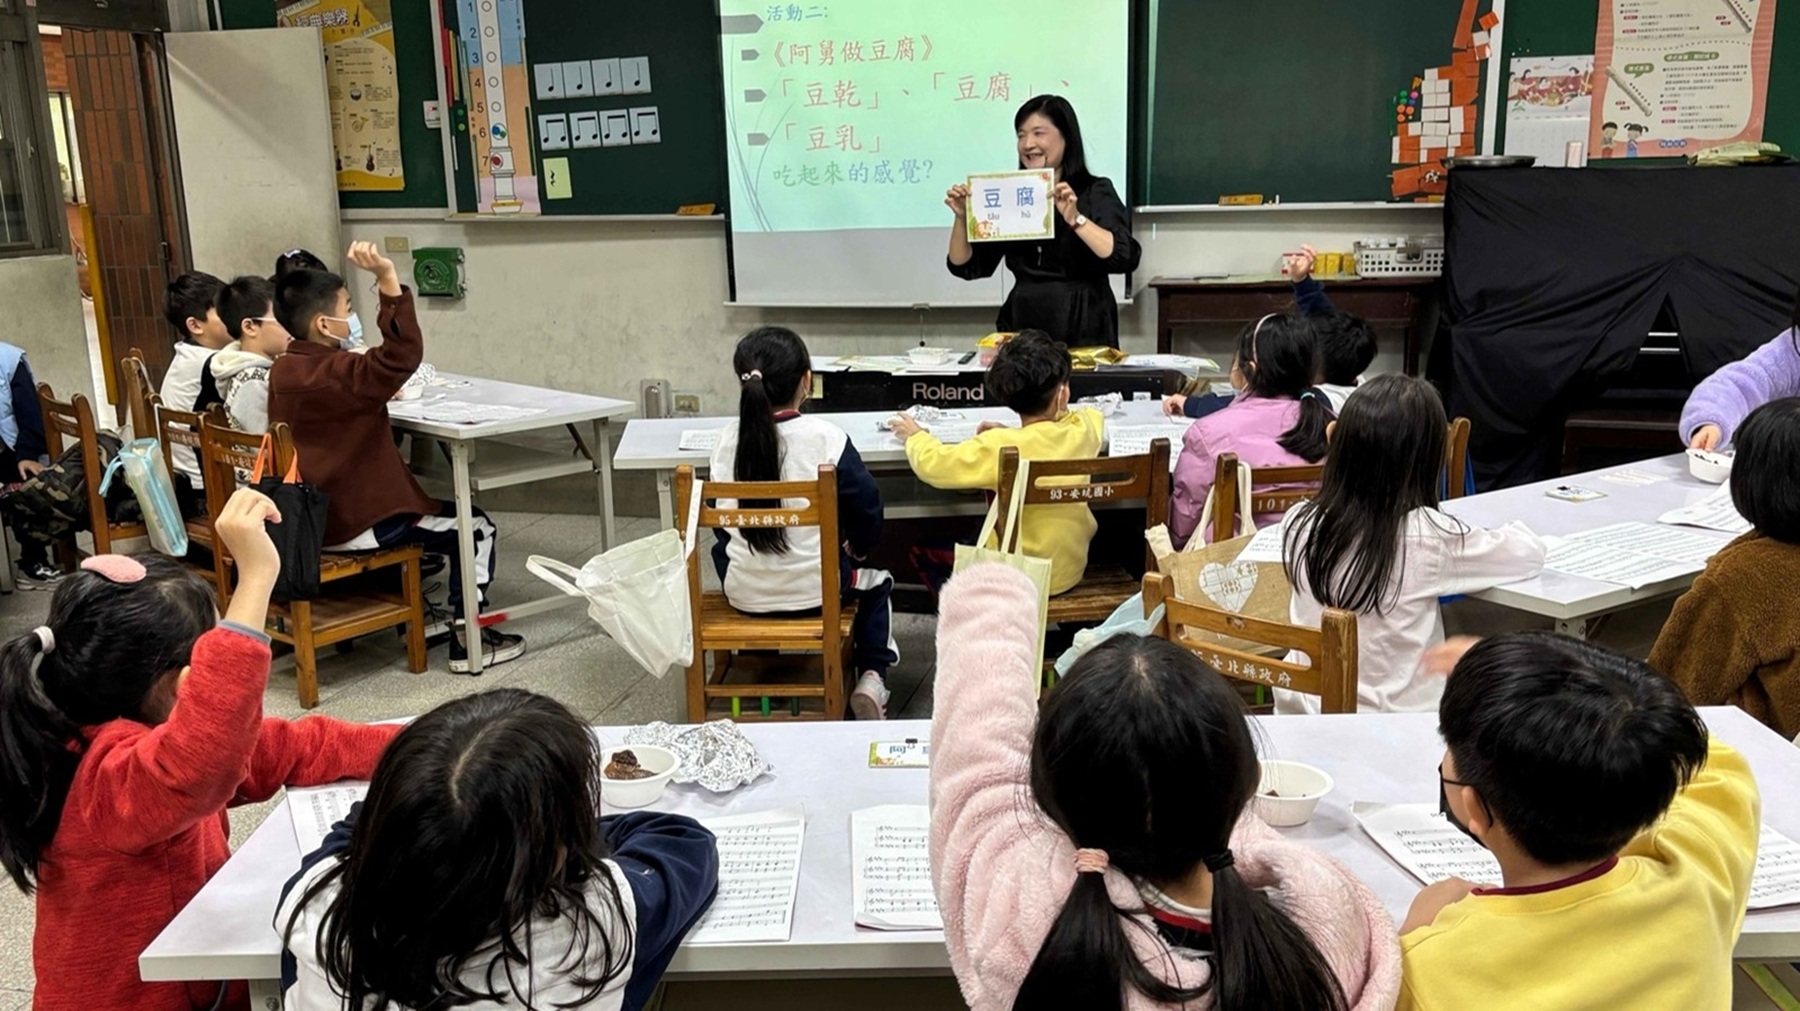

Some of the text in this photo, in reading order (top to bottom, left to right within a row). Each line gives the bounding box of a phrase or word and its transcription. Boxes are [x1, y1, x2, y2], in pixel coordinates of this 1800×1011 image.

[468, 2, 474, 13] 1
[470, 27, 477, 39] 2
[773, 34, 934, 68] 《阿舅做豆腐》
[472, 52, 479, 63] 3
[474, 78, 481, 88] 4
[477, 103, 484, 114] 5
[479, 127, 486, 138] 6
[482, 156, 489, 166] 7
[912, 382, 984, 401] Roland
